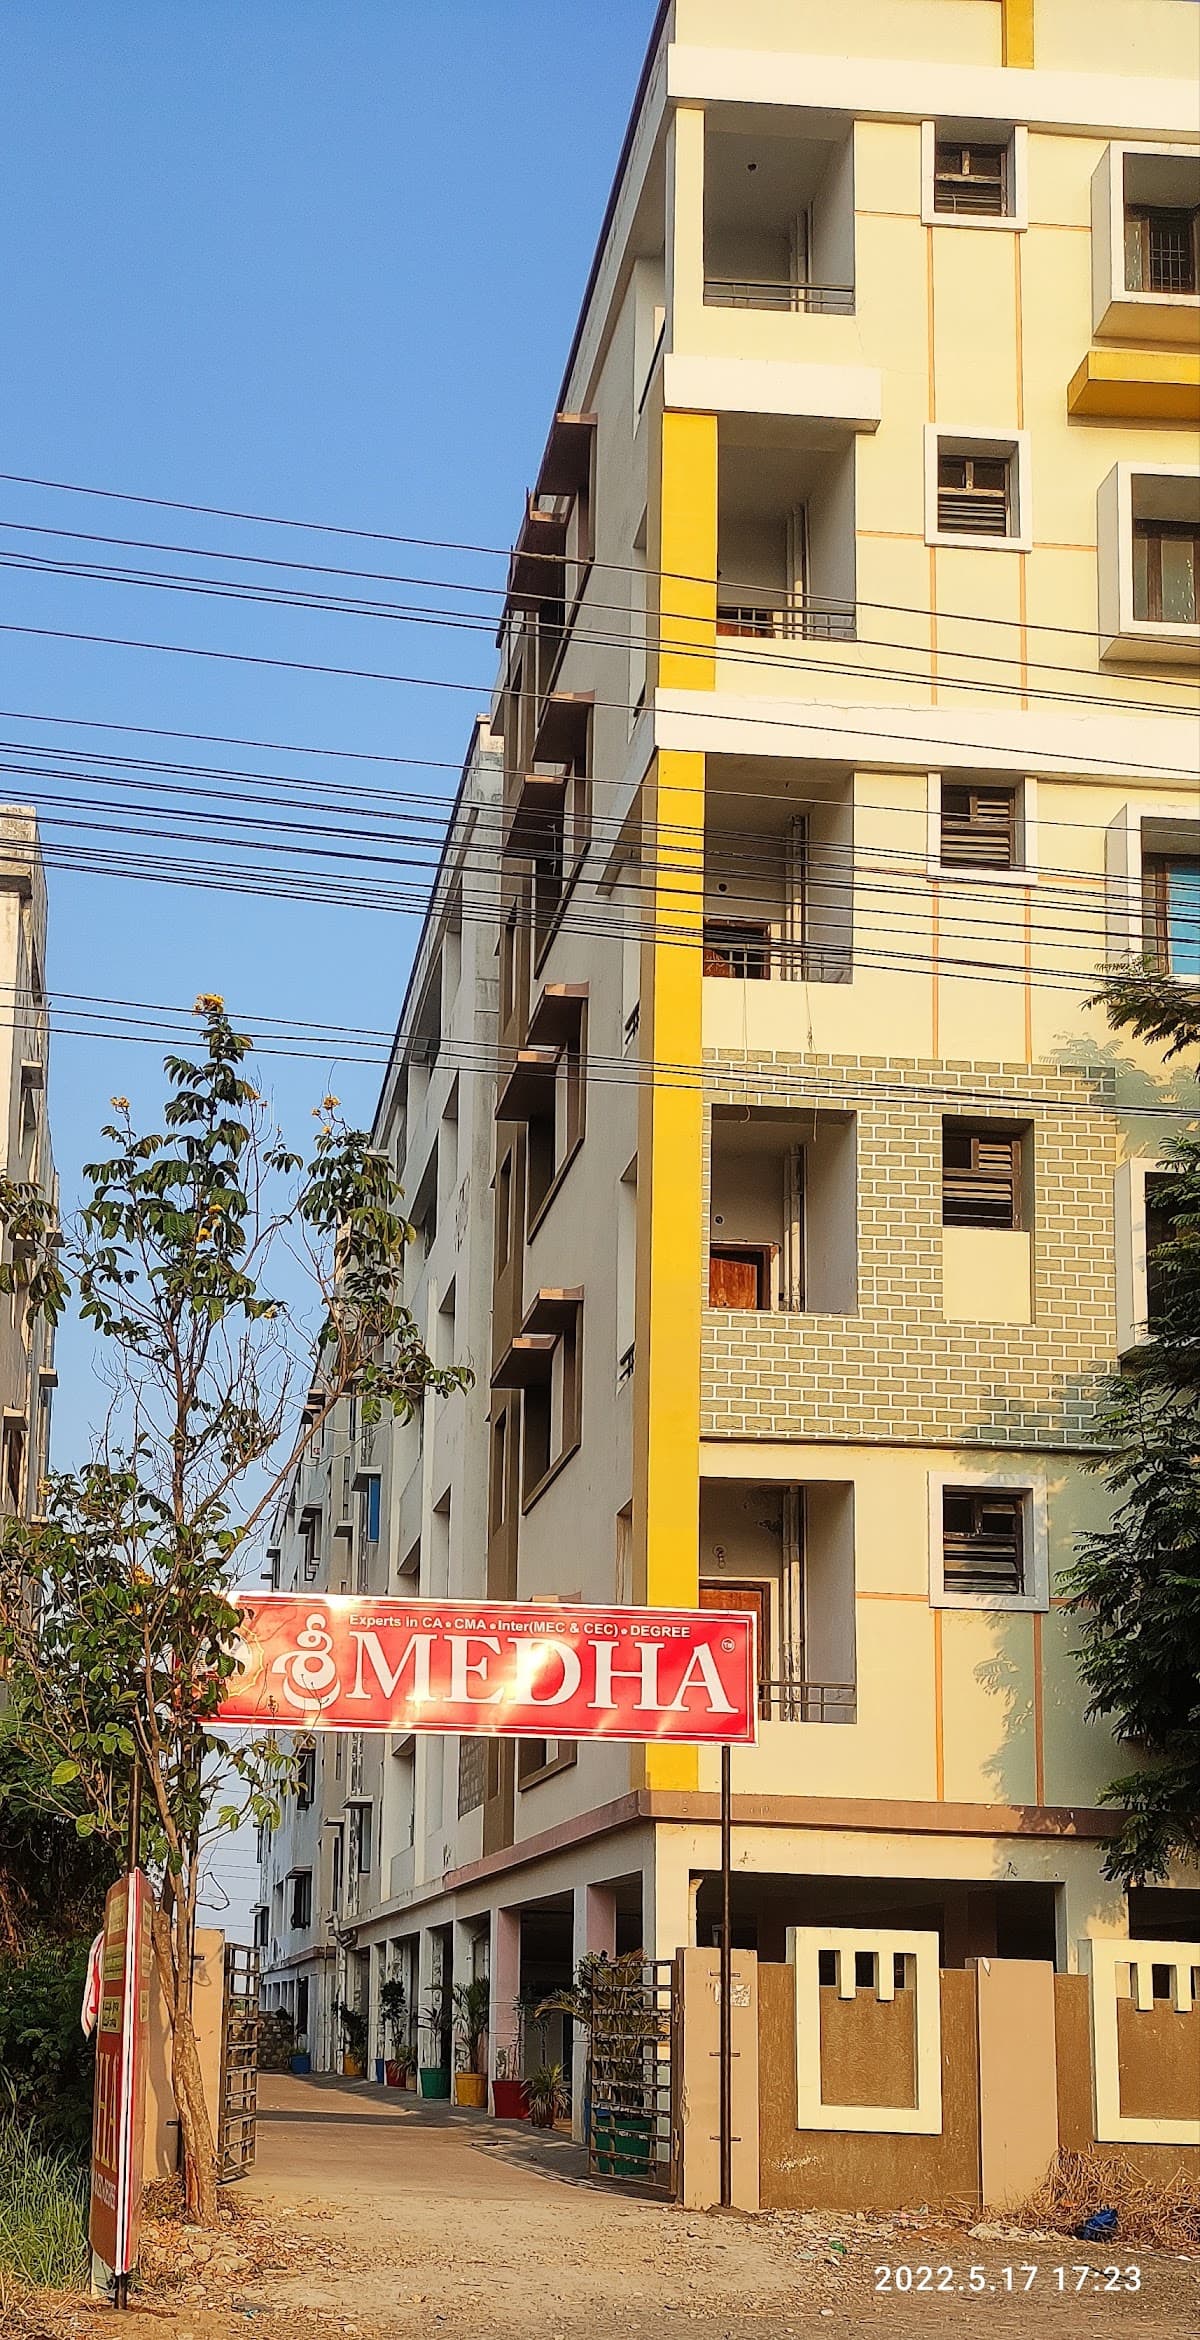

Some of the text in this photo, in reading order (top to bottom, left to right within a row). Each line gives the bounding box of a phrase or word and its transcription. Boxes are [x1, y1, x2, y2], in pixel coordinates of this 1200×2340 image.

[349, 1614, 401, 1629] Experts
[422, 1617, 443, 1629] CA
[454, 1618, 487, 1630] CMA
[498, 1620, 566, 1635] Inter(MEC
[569, 1622, 580, 1634] &
[583, 1622, 619, 1638] CEC)
[630, 1625, 691, 1638] DEGREE
[347, 1631, 740, 1714] MEDHA
